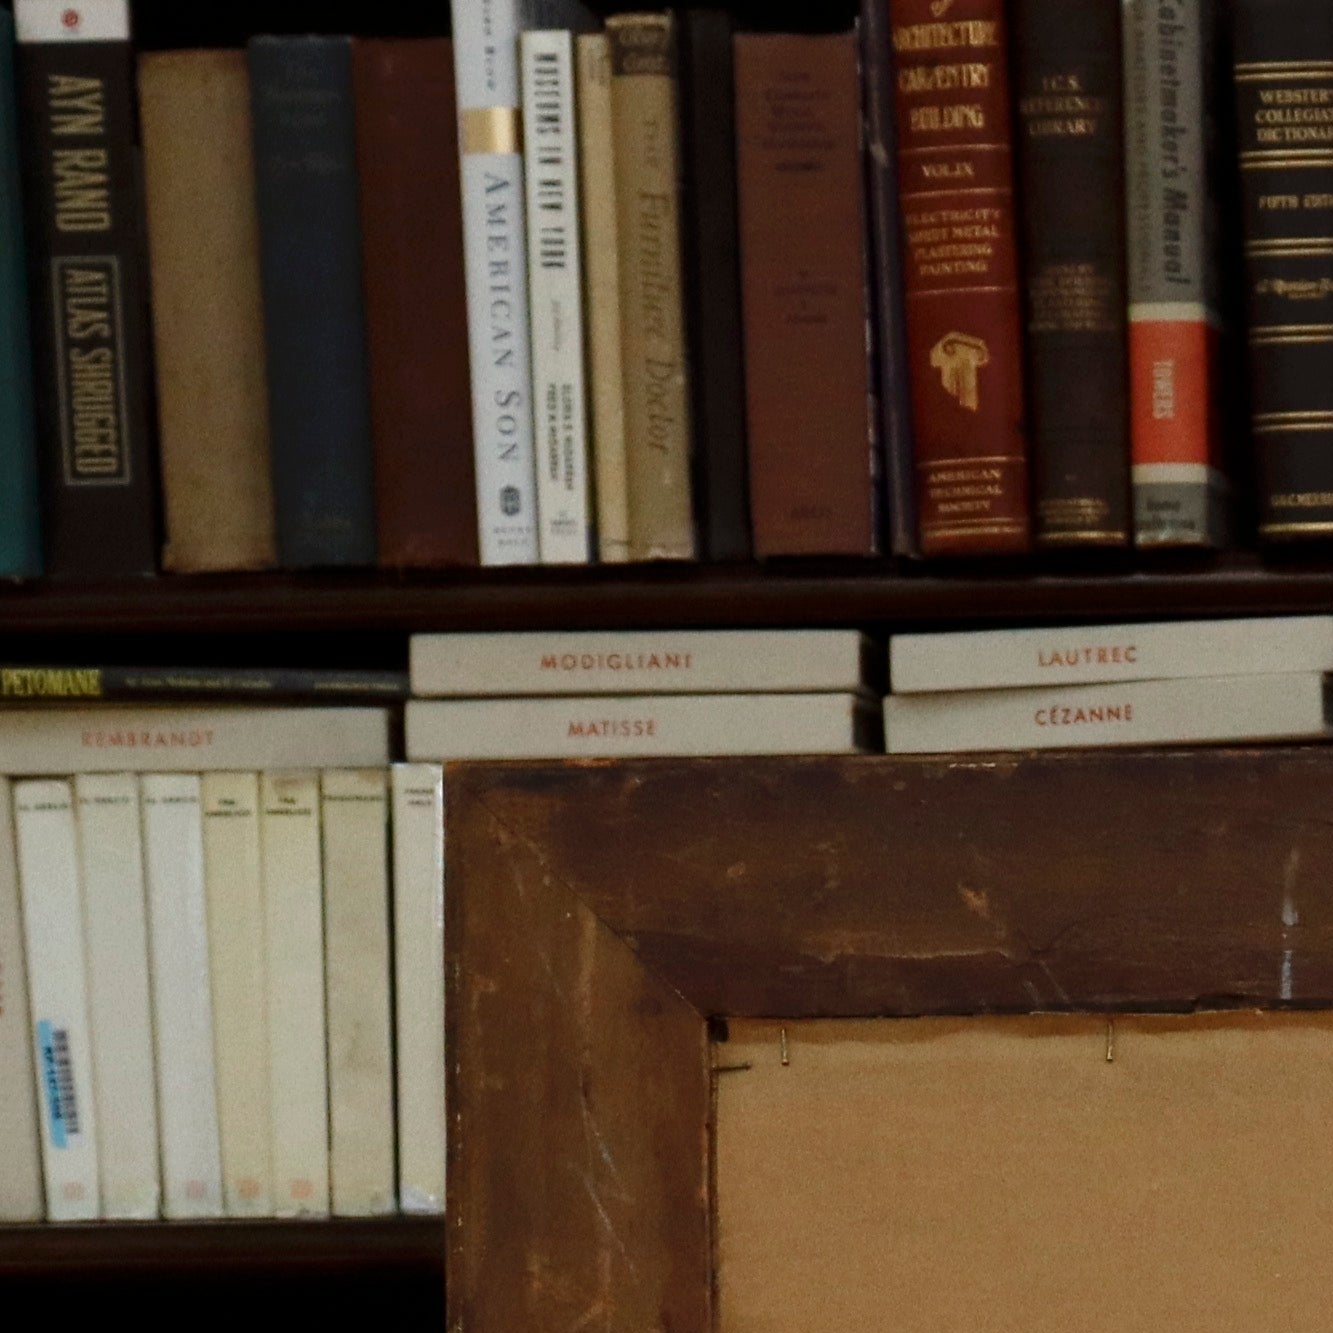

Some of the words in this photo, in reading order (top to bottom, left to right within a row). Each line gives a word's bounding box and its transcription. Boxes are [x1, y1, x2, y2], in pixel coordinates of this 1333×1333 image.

[48, 75, 104, 134] AYN
[52, 148, 111, 232] RAND
[484, 171, 514, 369] AMERICAN
[541, 226, 566, 270] YORK
[638, 192, 673, 338] Furniture
[1163, 188, 1192, 284] Manual
[65, 270, 111, 338] ATLAS
[69, 347, 118, 475] SHRUGGED
[494, 389, 520, 462] SON
[643, 358, 678, 452] Doctor
[541, 653, 692, 671] MODIGLIANI
[1038, 646, 1137, 667] LAUTREC
[81, 730, 214, 749] REMBRANDT
[567, 719, 656, 737] MATISSE
[1034, 704, 1134, 726] CÉZANNE
